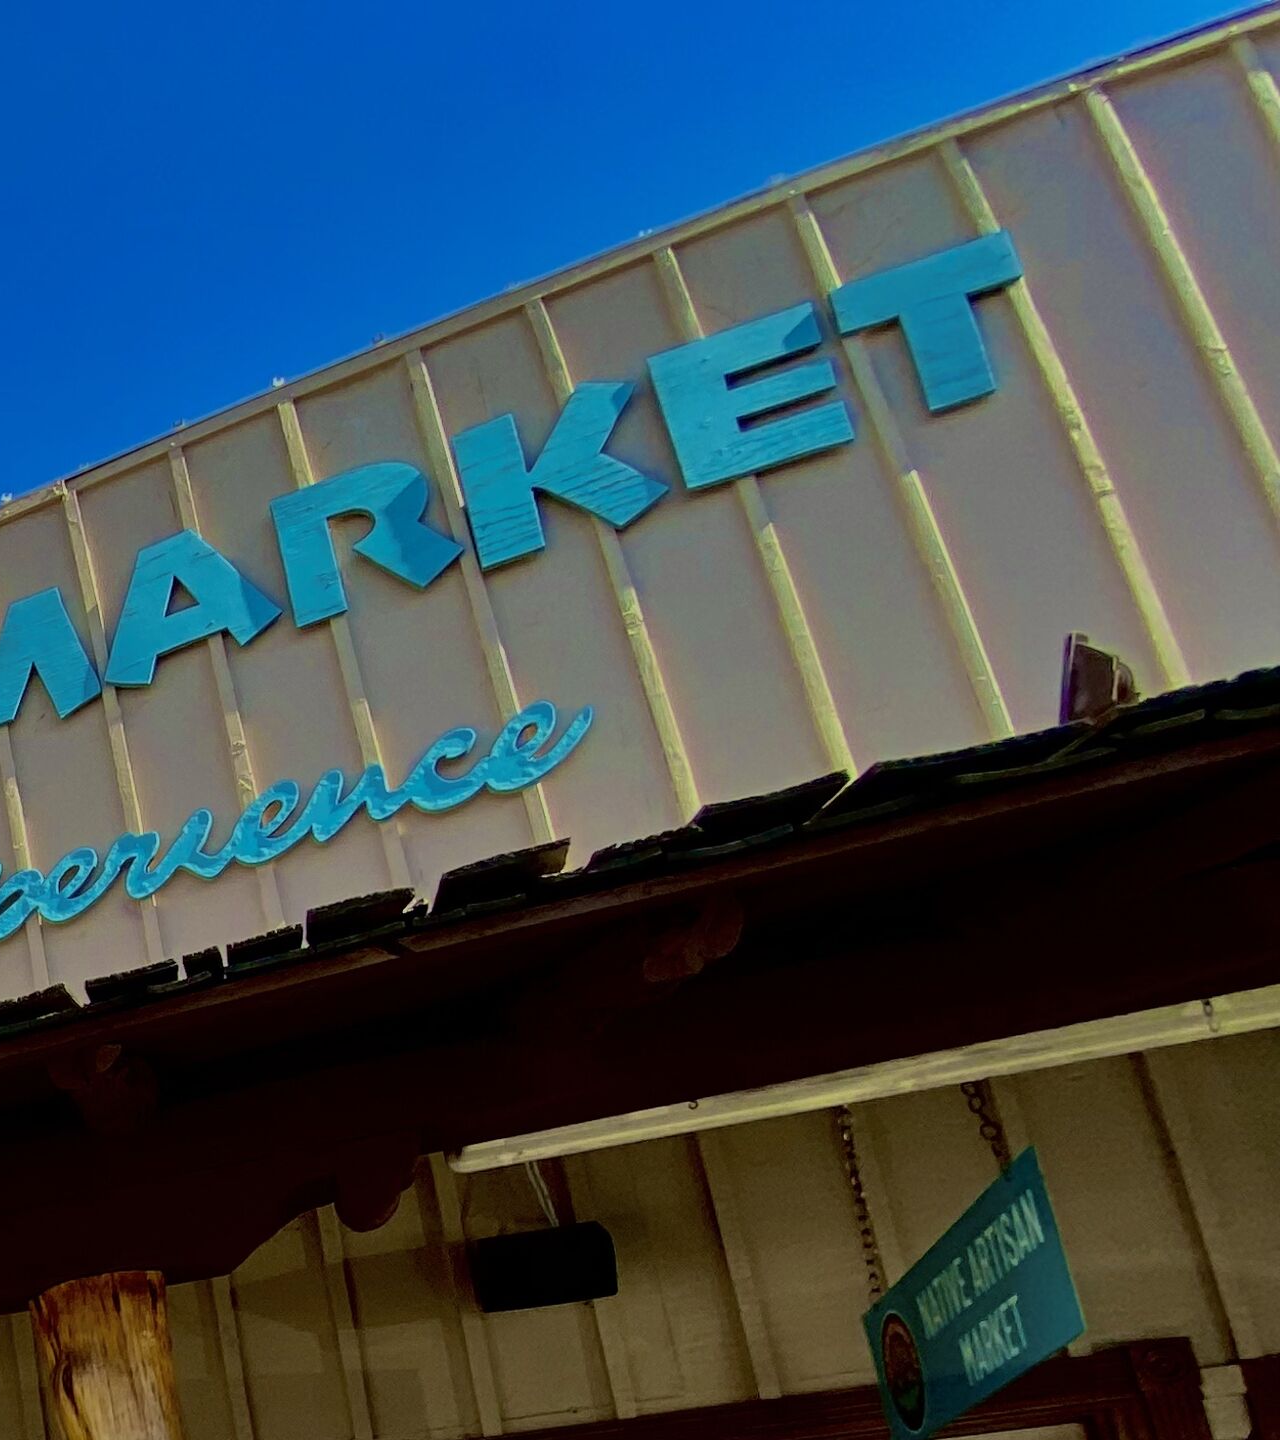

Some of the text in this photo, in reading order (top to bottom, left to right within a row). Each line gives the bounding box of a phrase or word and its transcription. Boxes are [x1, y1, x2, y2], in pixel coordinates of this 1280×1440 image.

[916, 1188, 1045, 1340] NATIVE ARTISAN
[958, 1294, 1028, 1387] MARKET
